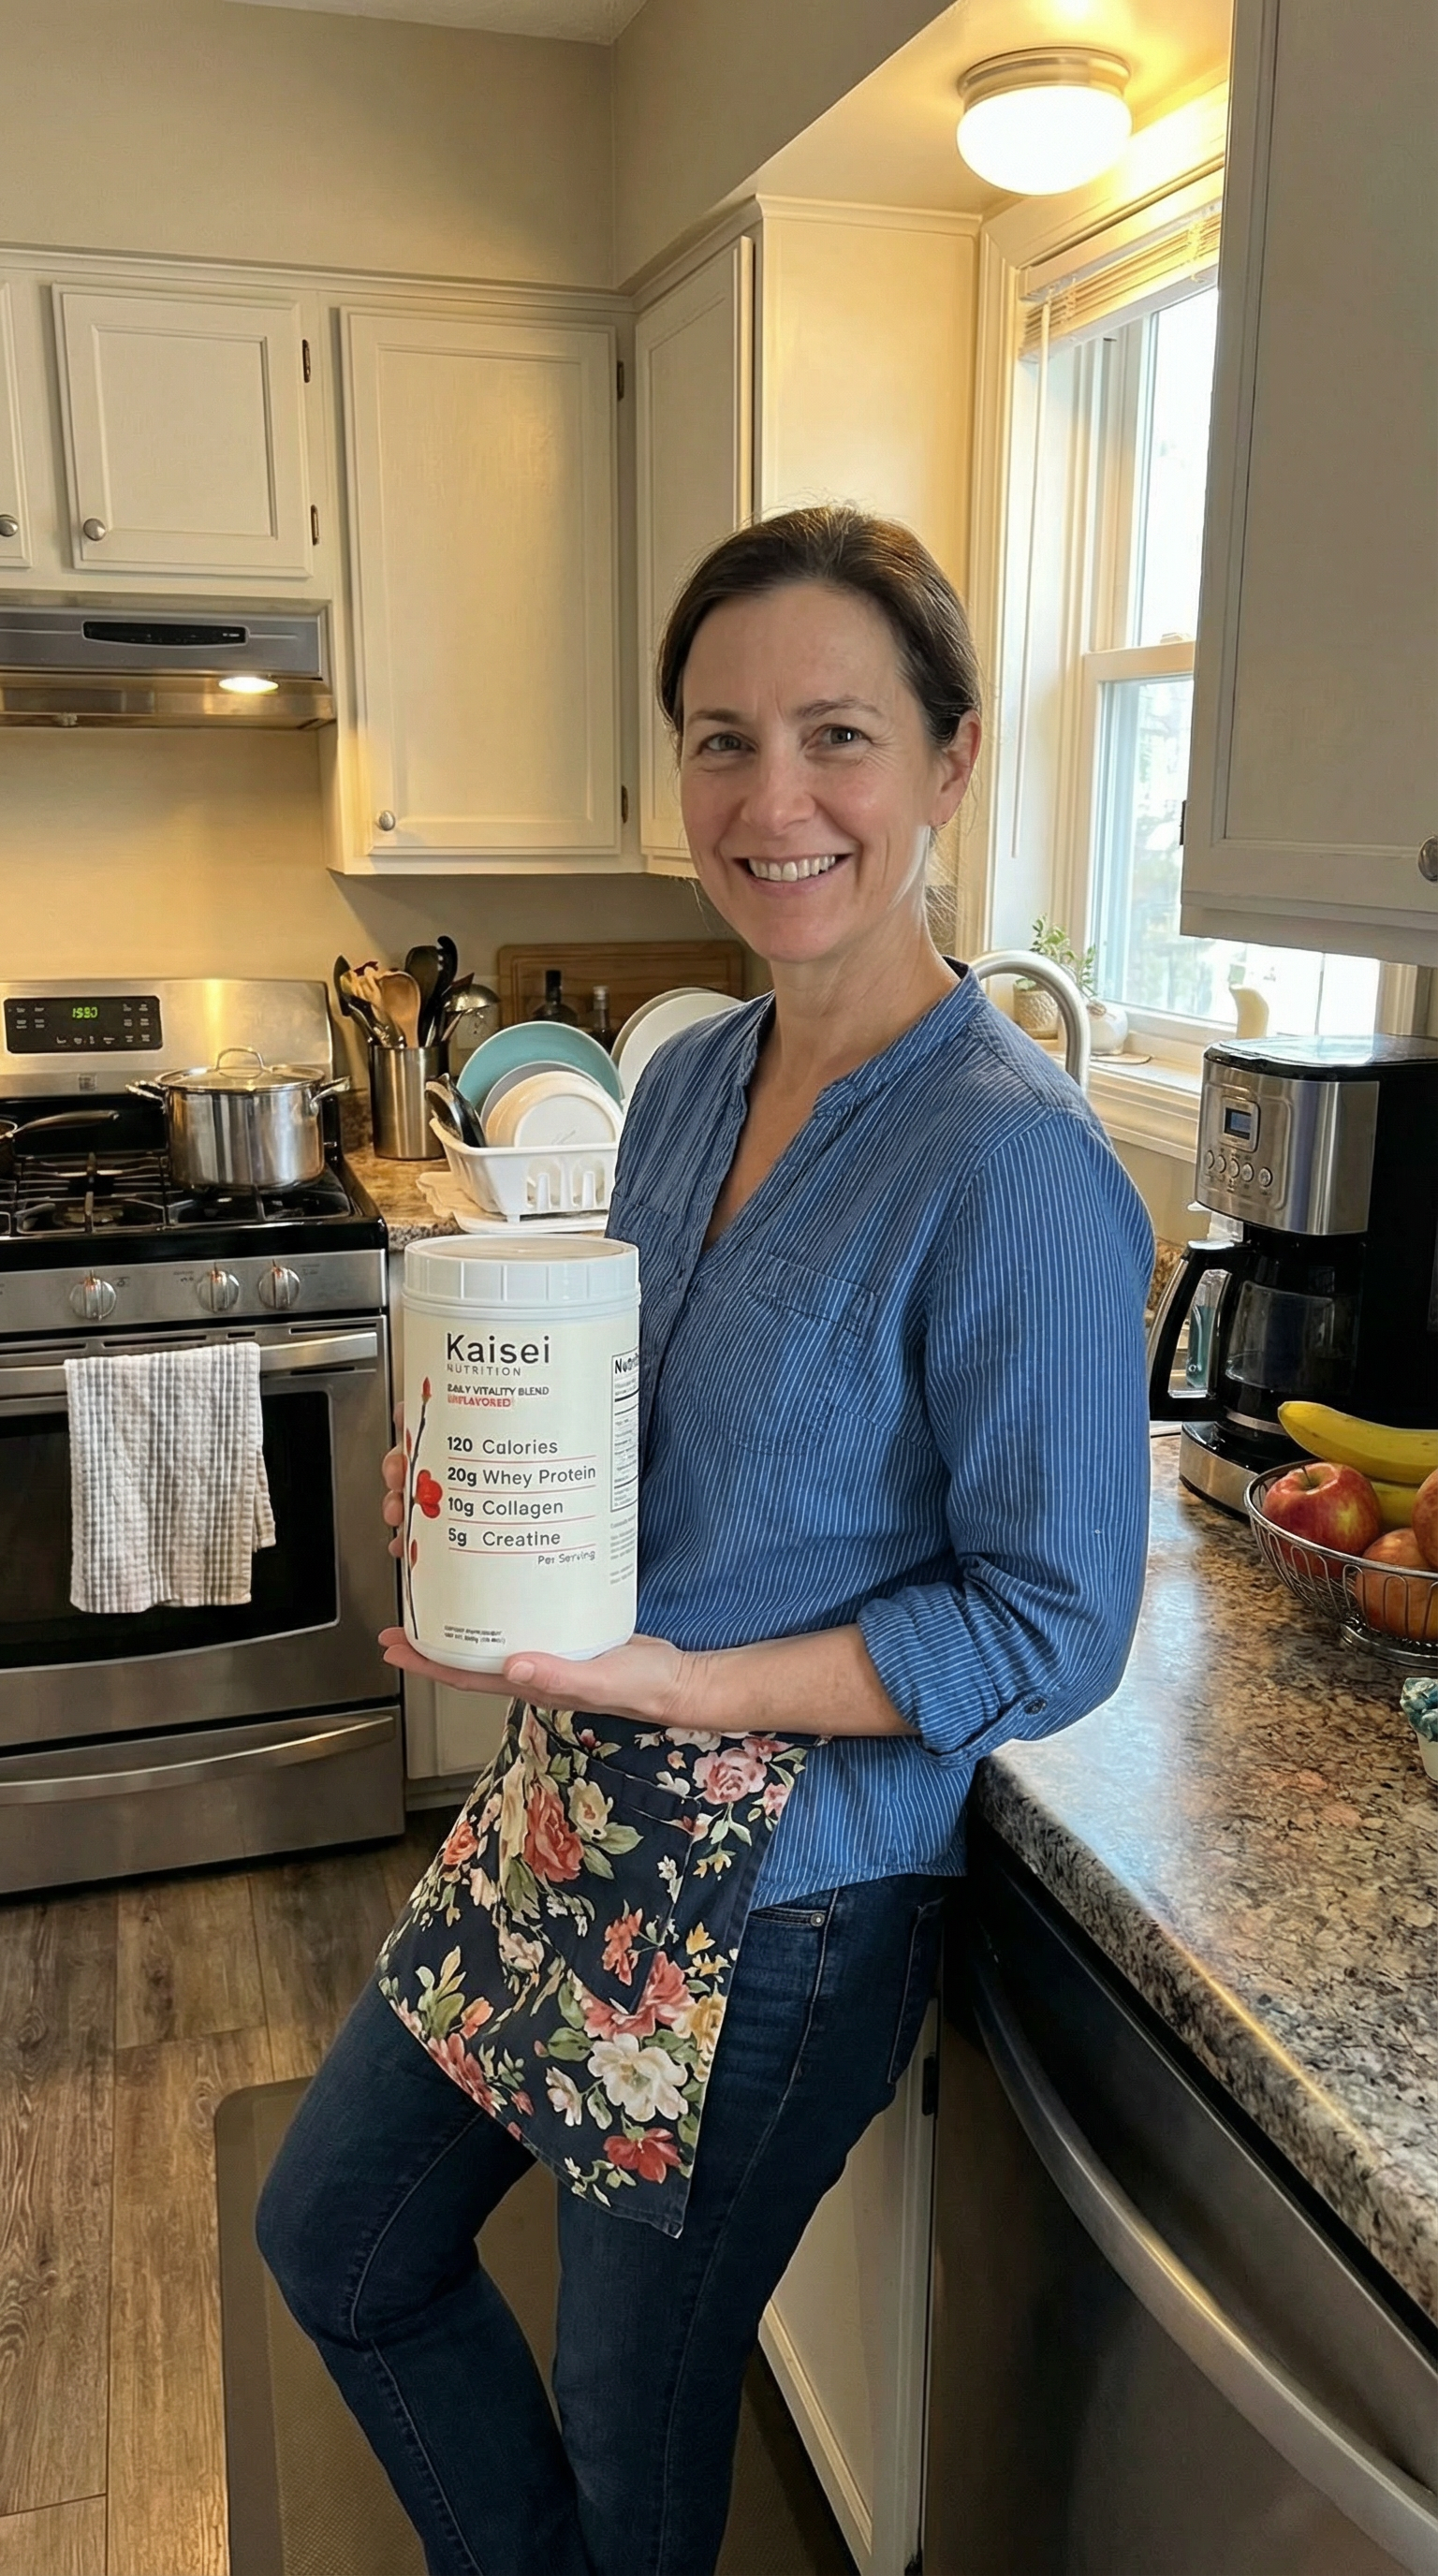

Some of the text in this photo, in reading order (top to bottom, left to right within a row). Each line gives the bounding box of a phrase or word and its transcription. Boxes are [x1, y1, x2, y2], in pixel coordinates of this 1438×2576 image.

[447, 1332, 550, 1364] Kaisei
[447, 1364, 521, 1376] NUTRITION
[473, 1385, 517, 1396] VITALITY
[518, 1386, 550, 1396] BLEND
[448, 1436, 559, 1456] 120 Calories
[448, 1465, 596, 1488] 20g Whey Protein
[448, 1497, 564, 1519] 10g Collagen
[448, 1528, 561, 1547] 5g Creatine
